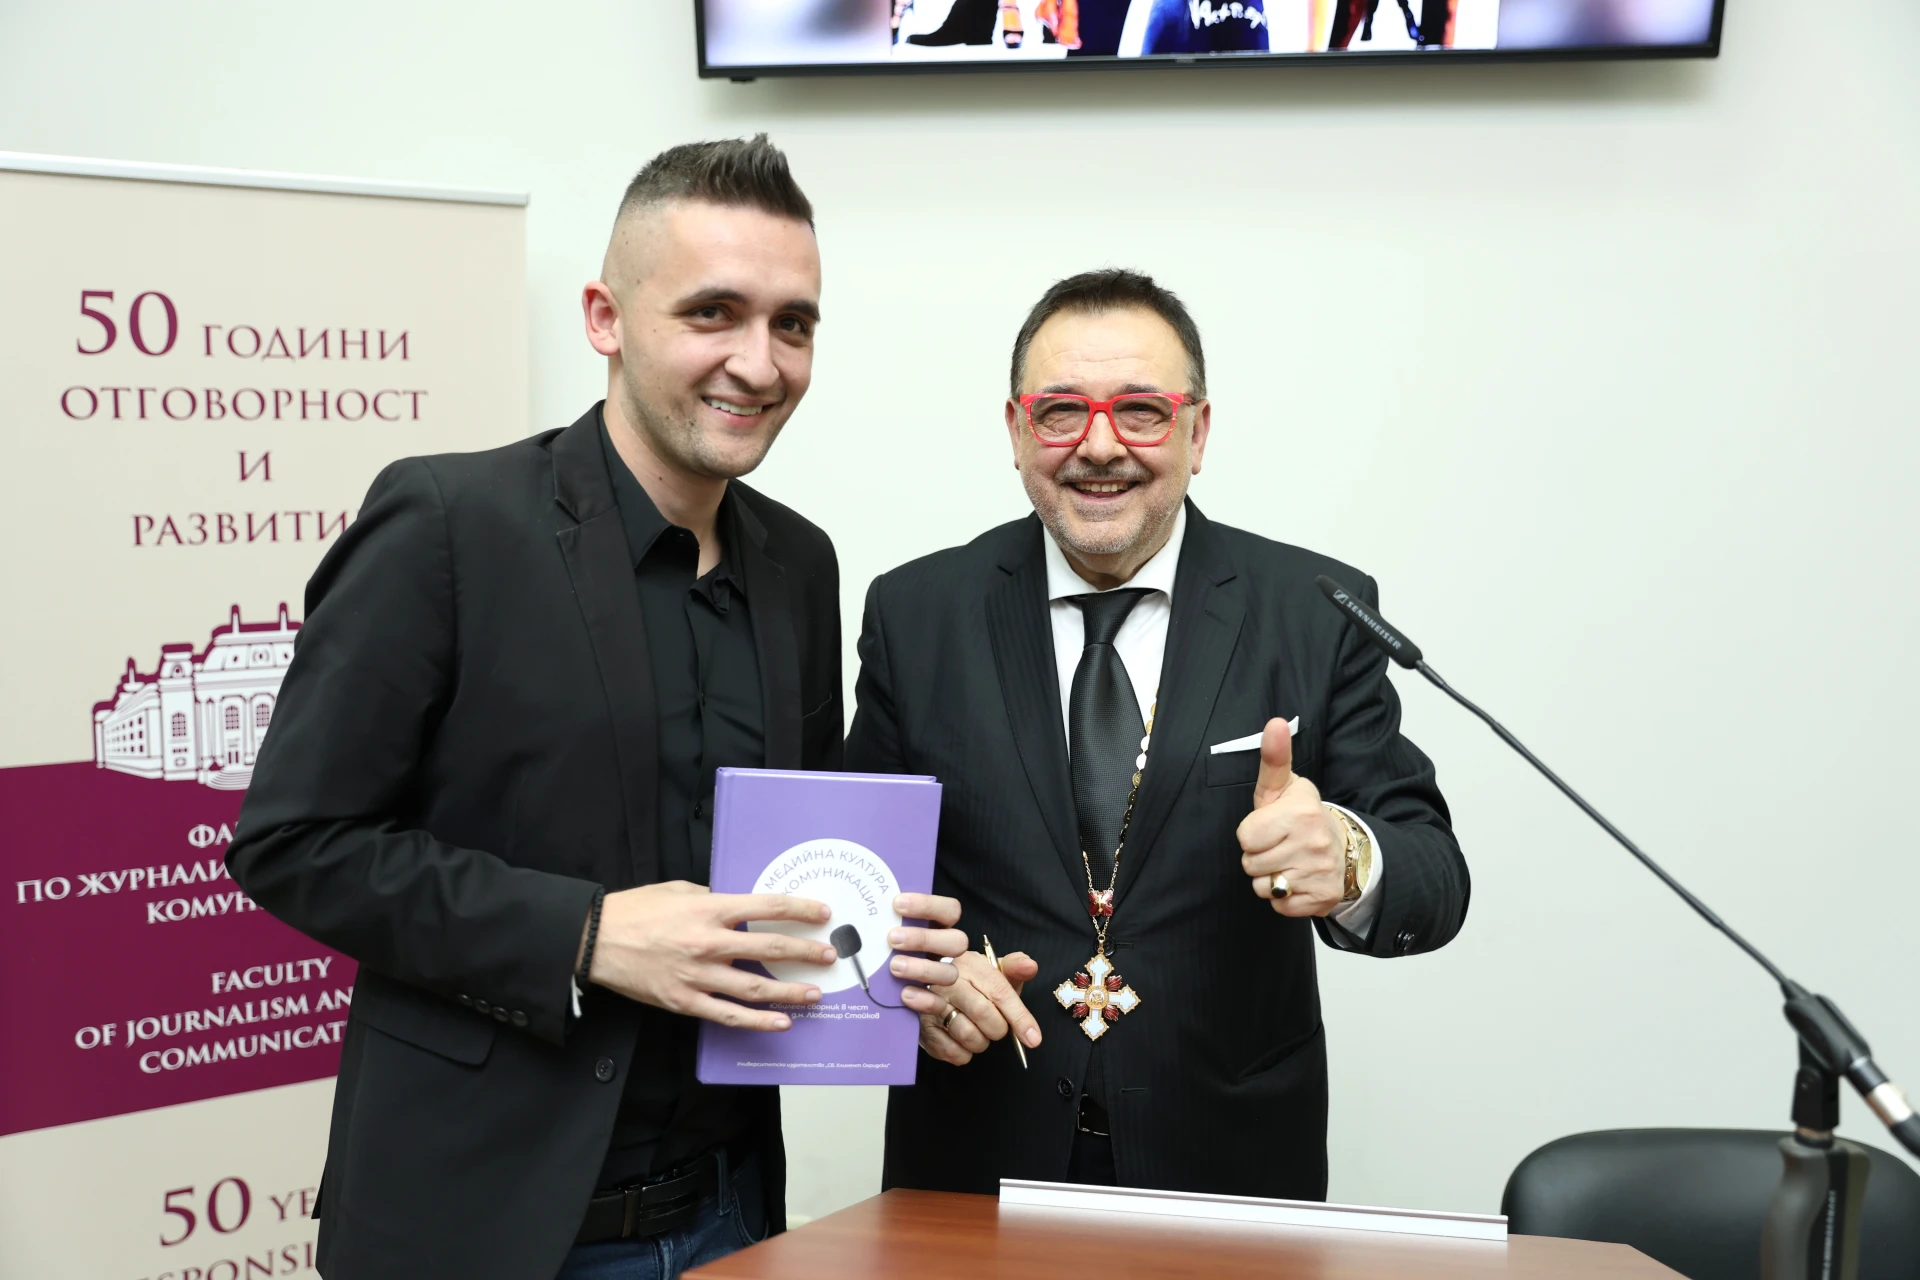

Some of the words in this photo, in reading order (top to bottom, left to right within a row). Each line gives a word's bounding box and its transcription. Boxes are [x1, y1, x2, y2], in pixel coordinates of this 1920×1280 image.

[76, 289, 179, 358] 50
[202, 324, 413, 364] ГОДИНИ
[60, 385, 429, 423] ОТГОВОРНОСТ
[237, 450, 273, 482] И
[131, 510, 360, 547] РАЗВИТИ
[1346, 600, 1402, 650] SENNHEISER
[188, 821, 239, 848] ФА
[16, 877, 71, 904] ПО
[77, 859, 232, 897] ЖУРНАЛИ
[764, 849, 835, 890] МЕДИЙНА
[839, 850, 889, 894] КУЛТУРА
[781, 867, 878, 916] КОМУНИКАЦИЯ
[146, 890, 264, 924] КОМУН
[211, 956, 333, 994] FACULTY
[75, 1023, 117, 1050] OF
[126, 993, 310, 1047] JOURNALISM
[315, 986, 354, 1013] AN
[806, 1012, 843, 1020] Любомир
[807, 1003, 840, 1011] сборник
[139, 1020, 348, 1074] COMMUNICAT
[160, 1175, 252, 1248] 50
[267, 1187, 317, 1222] YE
